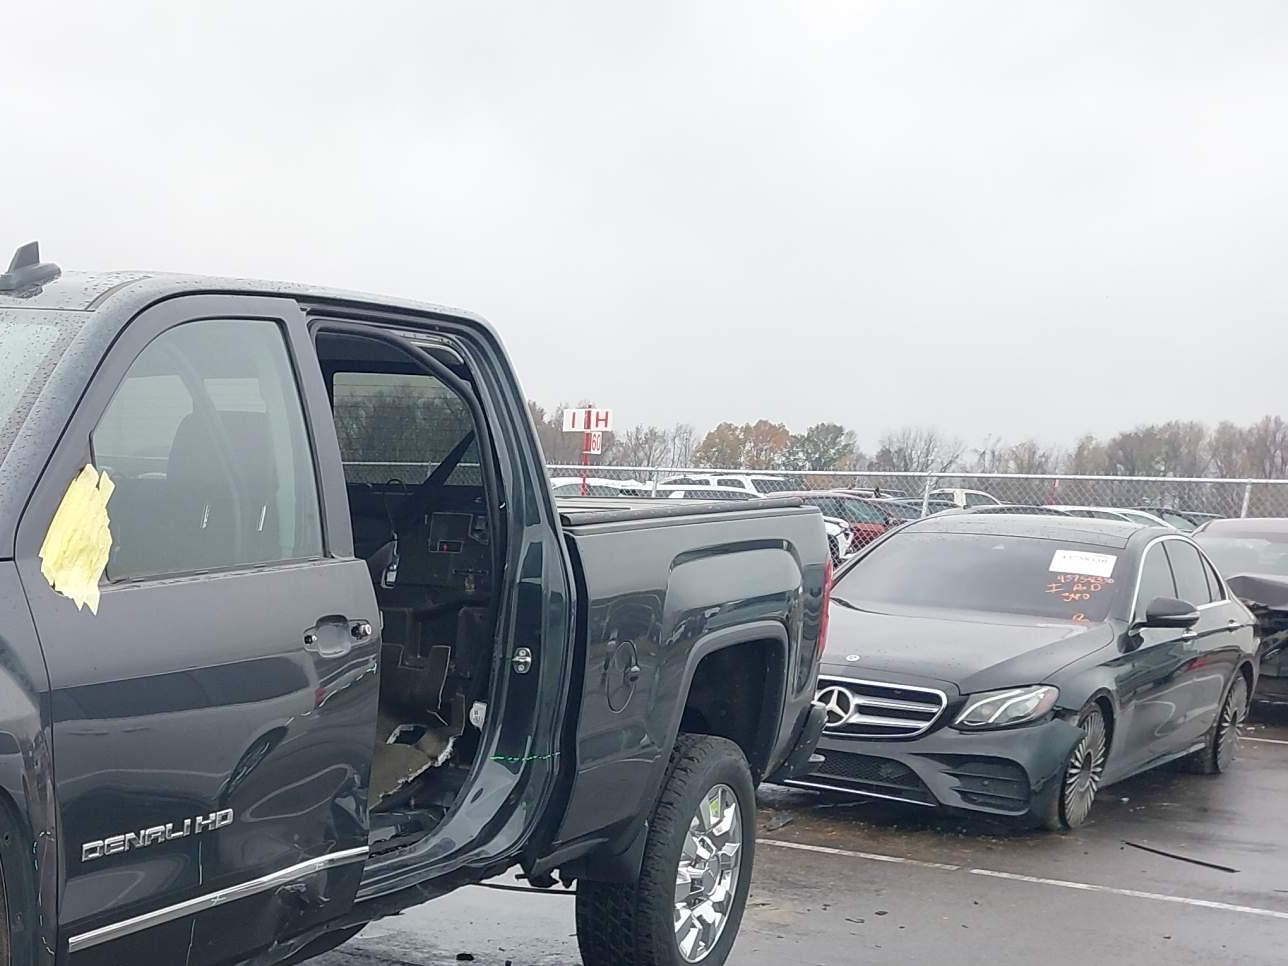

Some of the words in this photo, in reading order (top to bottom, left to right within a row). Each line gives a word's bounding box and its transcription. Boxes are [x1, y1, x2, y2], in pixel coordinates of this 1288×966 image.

[595, 411, 609, 428] H
[591, 433, 601, 451] 60
[81, 818, 192, 862] DENALI
[195, 808, 235, 834] HD
